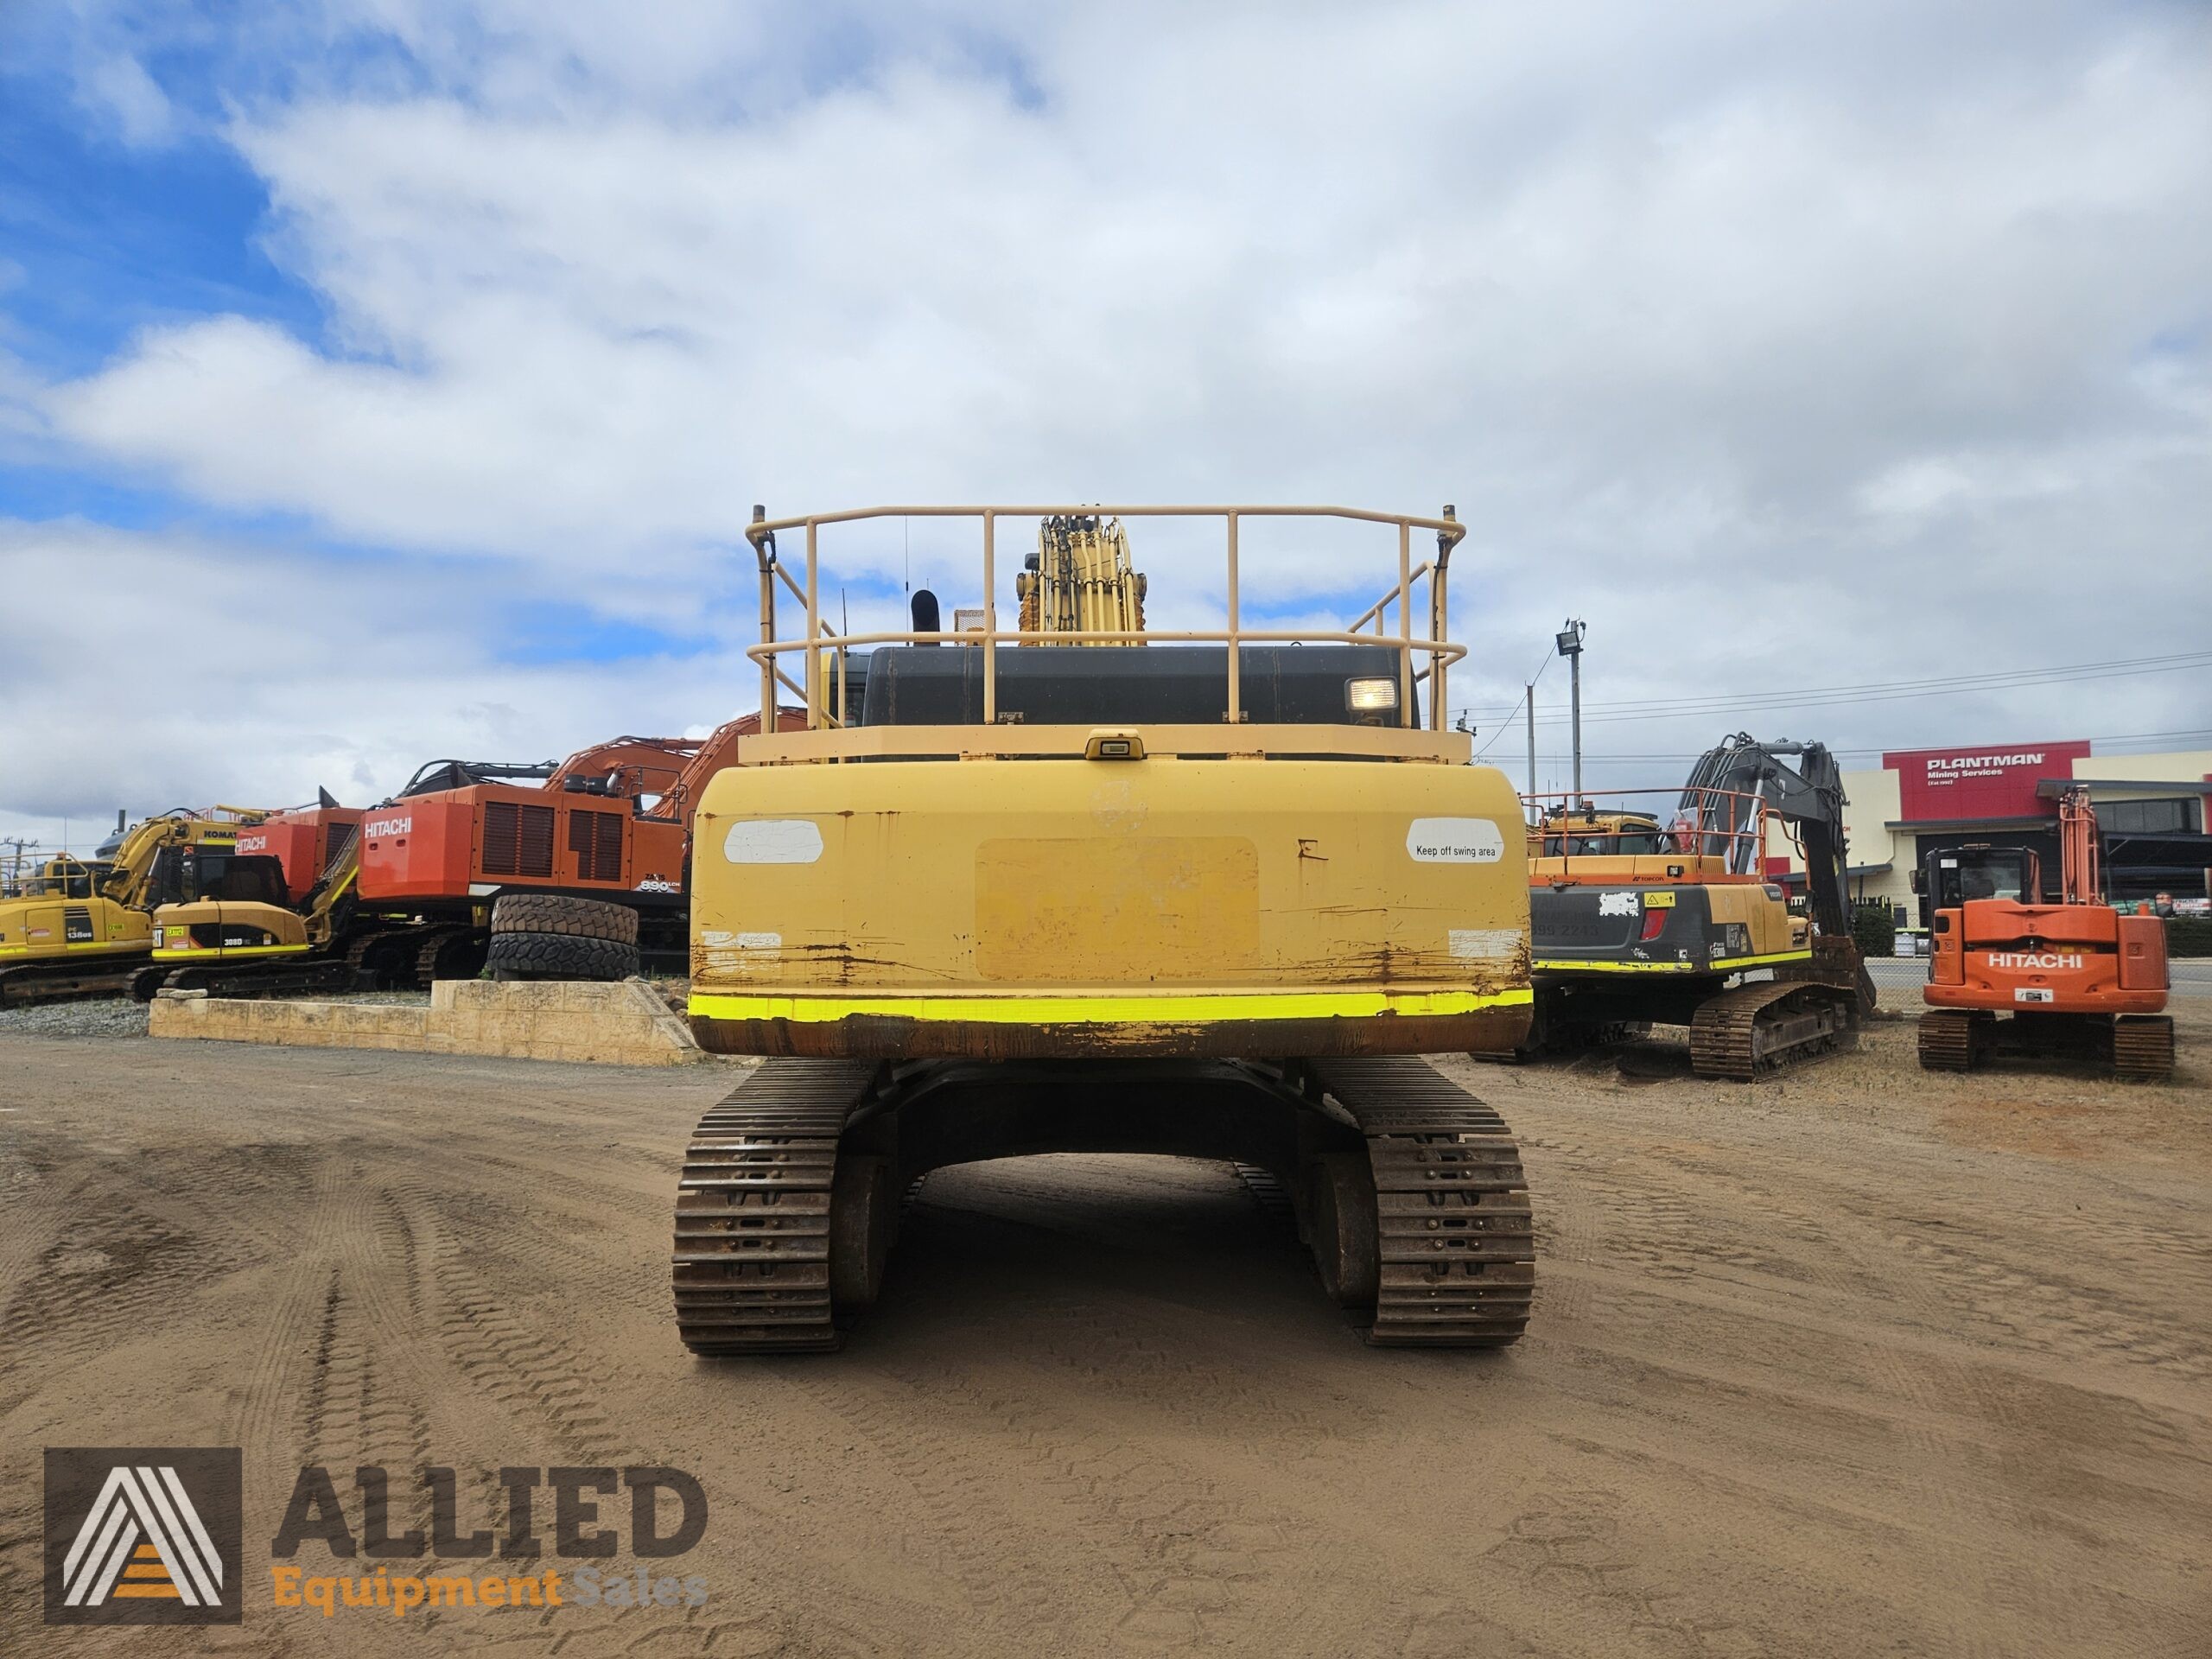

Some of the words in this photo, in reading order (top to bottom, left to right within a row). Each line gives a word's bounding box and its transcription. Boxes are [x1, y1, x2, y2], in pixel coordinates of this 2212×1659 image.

[1927, 753, 2042, 770] PLANTMAN
[365, 817, 412, 839] HITACHI
[235, 836, 266, 853] HITACHI
[1417, 845, 1437, 857] Keep
[1440, 846, 1452, 855] off
[1454, 846, 1476, 857] swing
[1478, 848, 1496, 856] area
[640, 880, 669, 892] 890
[1989, 954, 2082, 968] HITACHI
